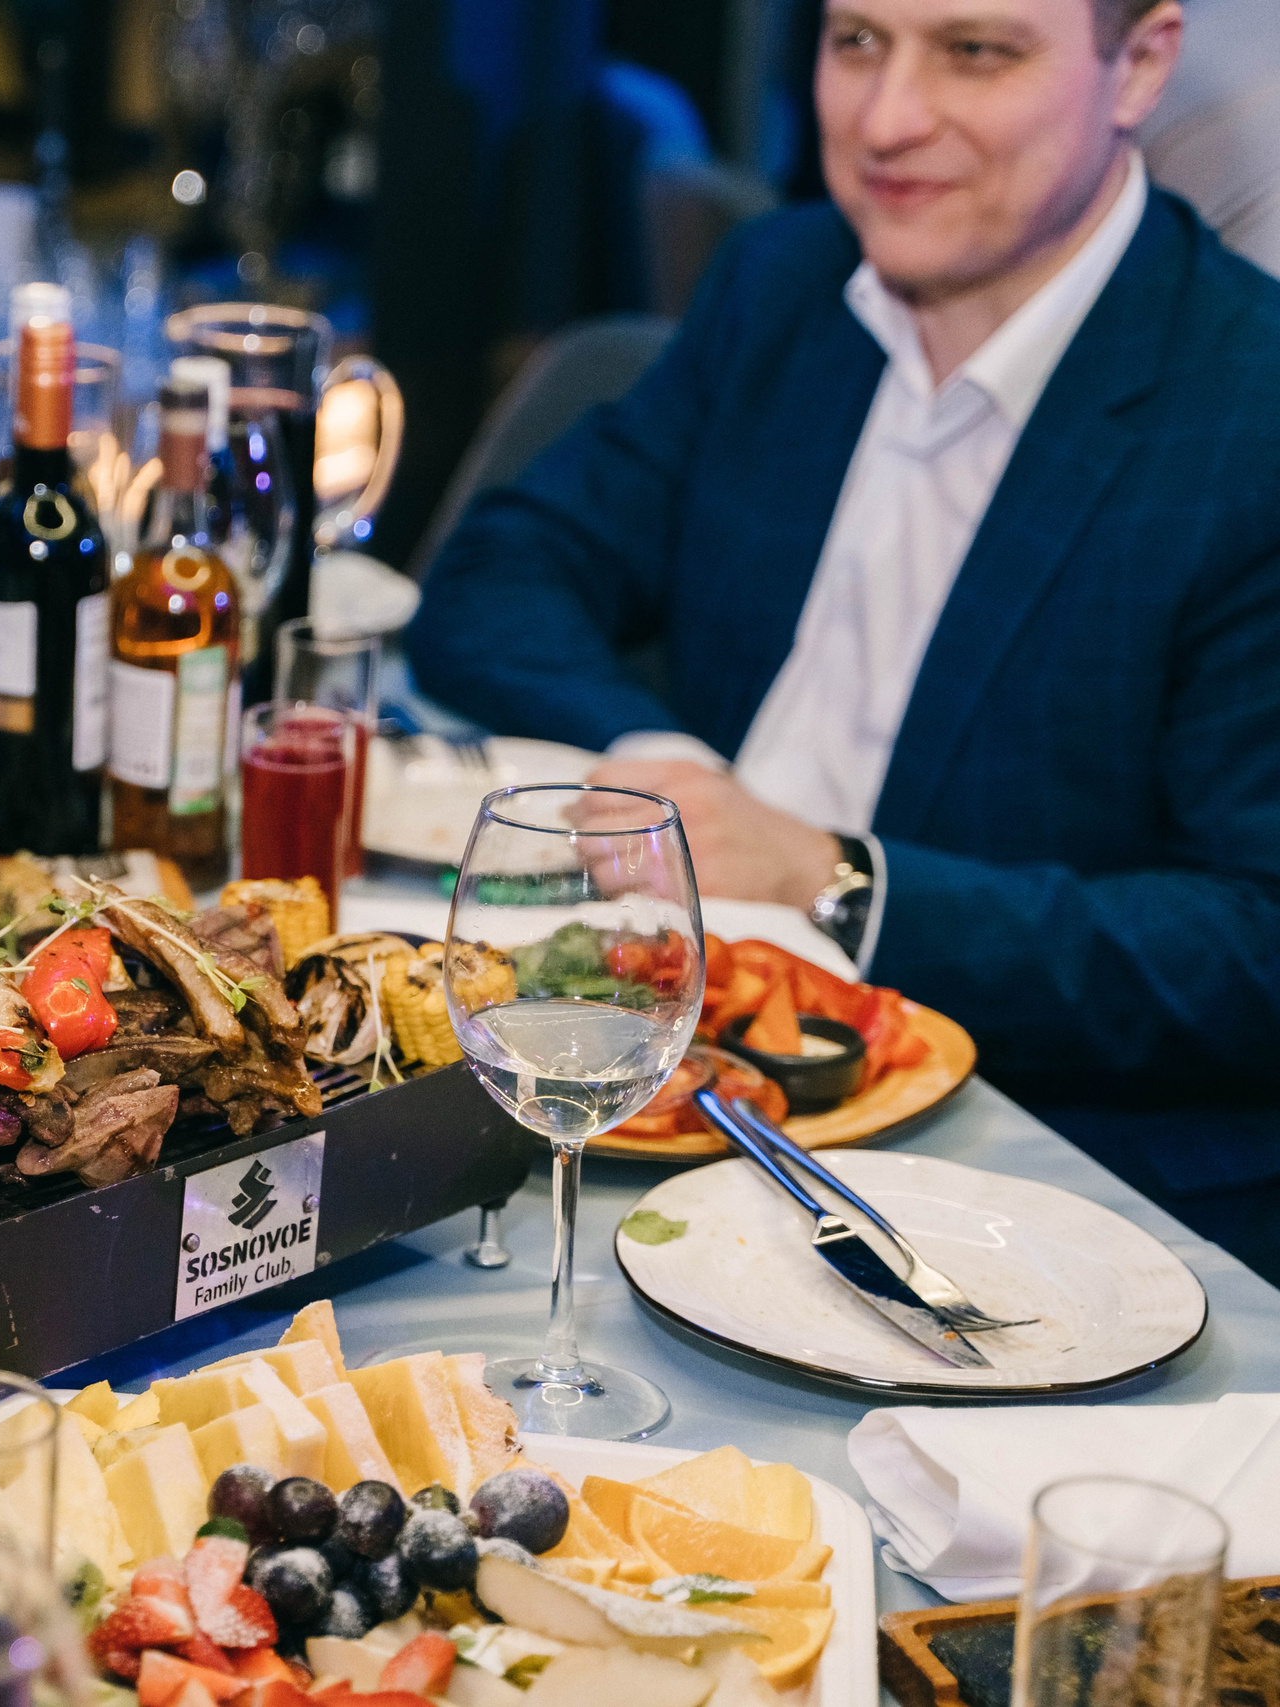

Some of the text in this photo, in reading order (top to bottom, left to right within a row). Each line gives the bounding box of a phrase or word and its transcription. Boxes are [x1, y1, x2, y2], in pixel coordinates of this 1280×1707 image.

[186, 1217, 312, 1283] SOSNOVOE
[194, 1257, 291, 1306] Family Club
